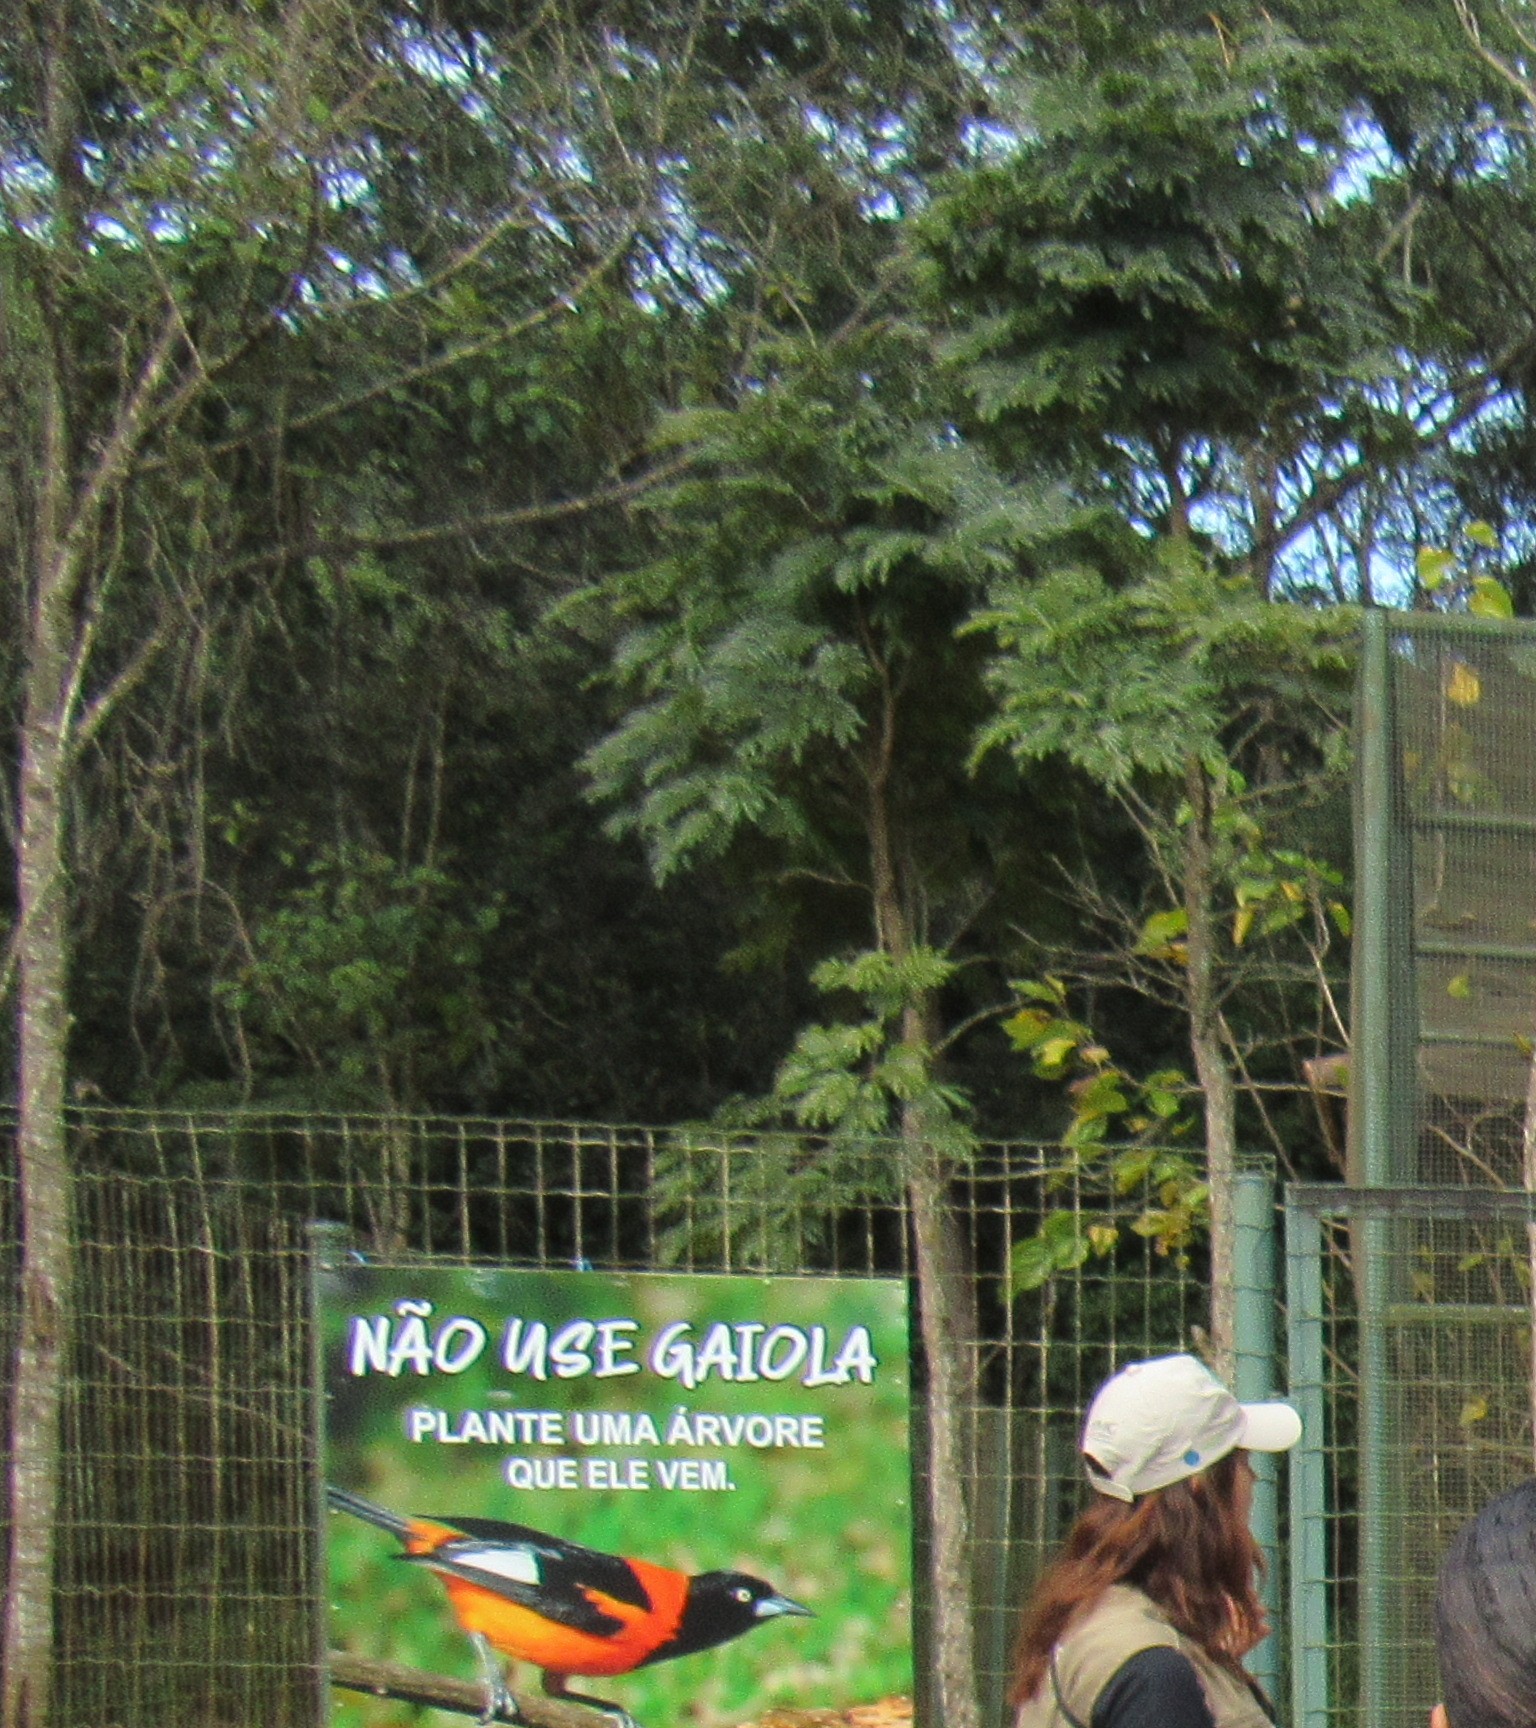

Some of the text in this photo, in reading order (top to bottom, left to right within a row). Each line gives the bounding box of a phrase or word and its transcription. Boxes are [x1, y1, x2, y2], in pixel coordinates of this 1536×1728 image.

[349, 1300, 878, 1388] NÃO USE GAIOLA
[409, 1406, 824, 1449] PLANTE UMA ÁRVORE
[508, 1458, 736, 1491] QUE ELE VEM.
